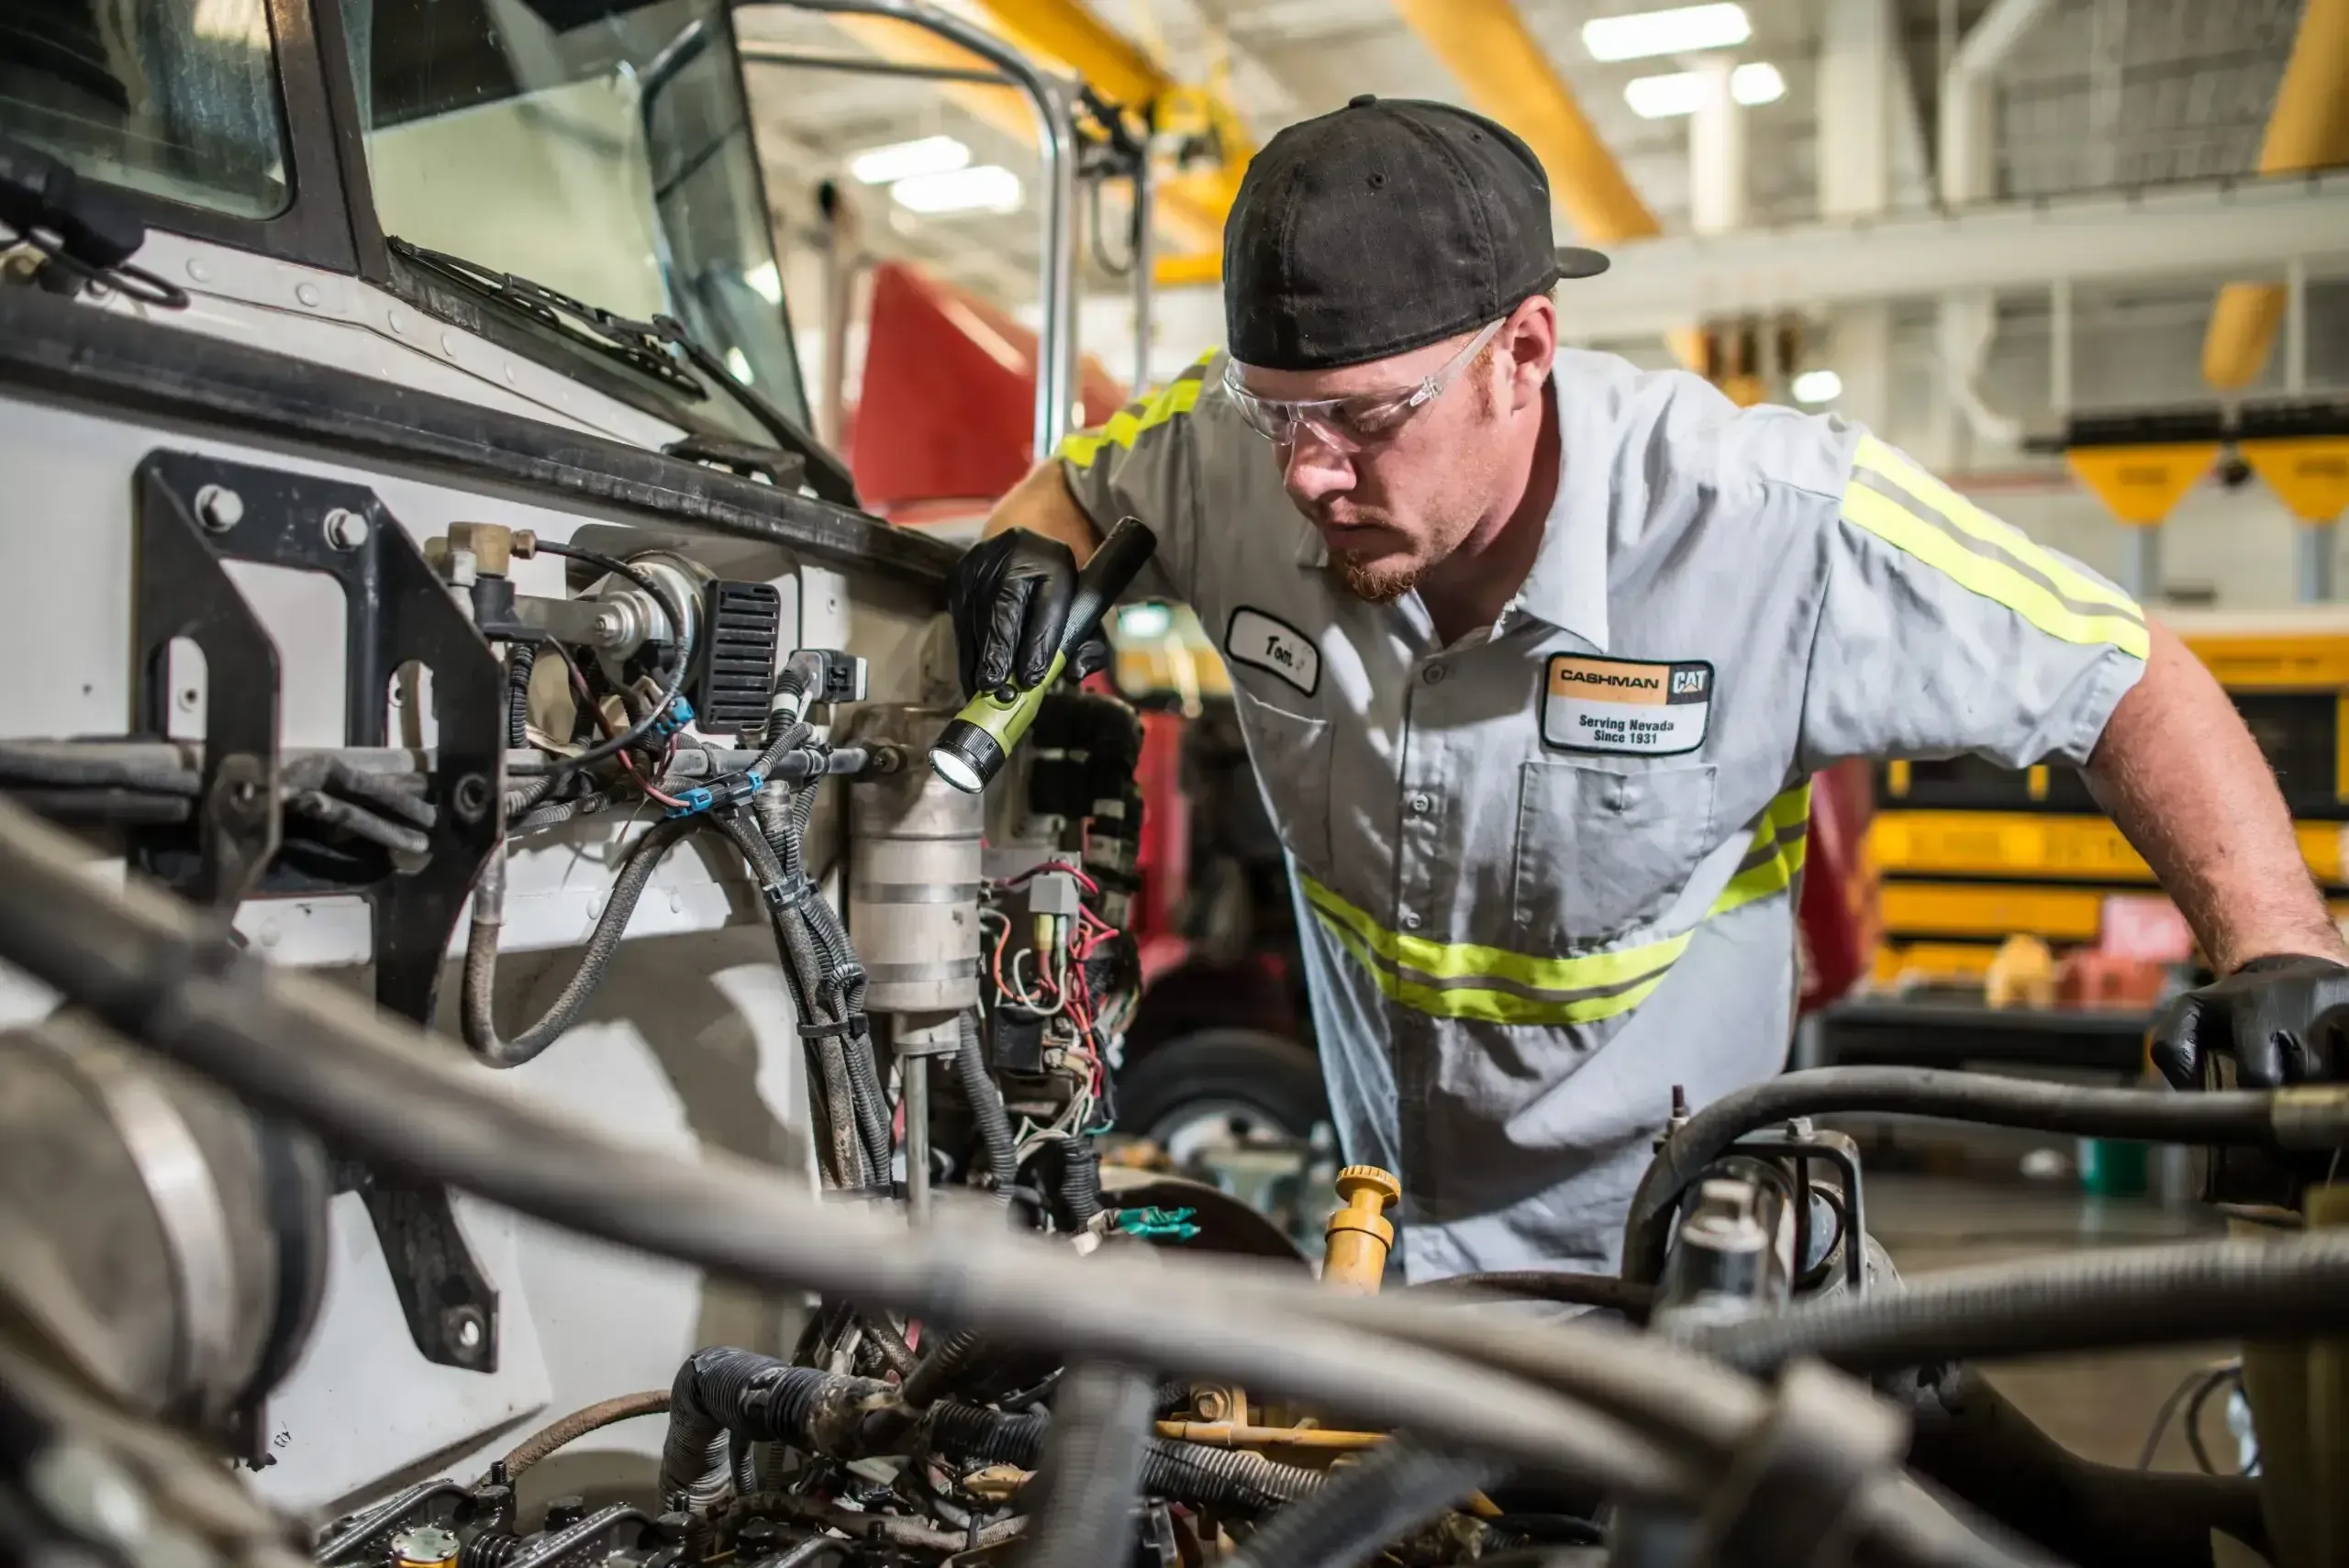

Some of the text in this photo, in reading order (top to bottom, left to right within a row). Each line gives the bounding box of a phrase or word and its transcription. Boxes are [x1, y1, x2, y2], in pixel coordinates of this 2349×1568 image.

[1561, 669, 1707, 694] CASHMAN CAT
[1579, 714, 1675, 732] Serving Nevada
[1593, 729, 1657, 744] Since 1931
